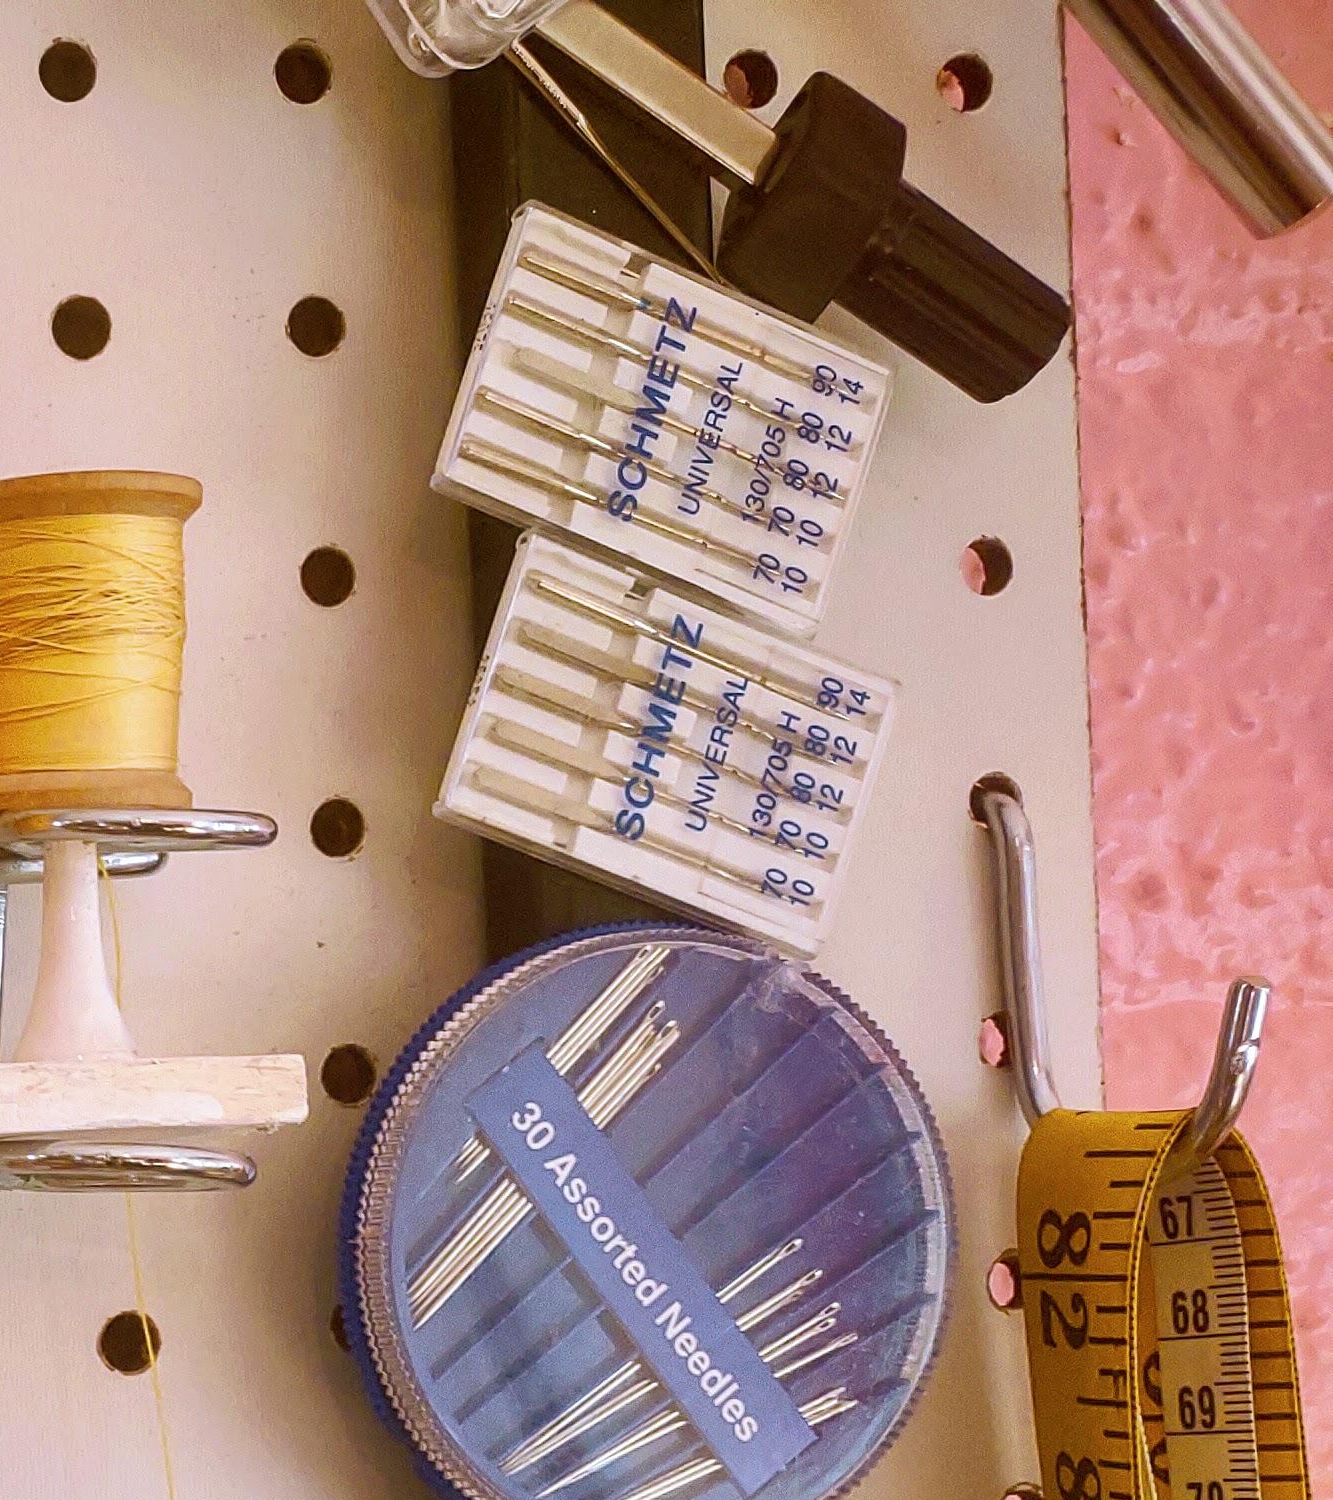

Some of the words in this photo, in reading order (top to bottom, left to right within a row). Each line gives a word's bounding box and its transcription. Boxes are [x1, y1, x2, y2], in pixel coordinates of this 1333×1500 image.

[607, 297, 697, 521] SCHMETZ
[678, 362, 743, 515] UNIVERSAL
[742, 426, 786, 523] 130/705
[774, 397, 794, 420] H
[753, 554, 781, 583] 70
[767, 505, 796, 533] 70
[783, 458, 809, 491] 80
[798, 411, 824, 444] 80
[813, 365, 838, 396] 90
[781, 566, 809, 594] 10
[796, 519, 824, 548] 10
[812, 473, 838, 500] 12
[825, 424, 852, 453] 12
[841, 376, 865, 405] 14
[615, 613, 704, 841] SCHMETZ
[684, 676, 749, 832] UNIVERSAL
[804, 724, 831, 757] 80
[817, 676, 844, 709] 90
[749, 741, 794, 838] 130/705
[781, 710, 802, 733] H
[774, 820, 802, 851] 70
[790, 772, 816, 804] 80
[791, 879, 815, 908] 10
[805, 831, 830, 860] 10
[819, 784, 844, 812] 12
[833, 735, 858, 766] 12
[847, 689, 872, 718] 14
[760, 867, 788, 898] 70
[510, 1101, 556, 1154] 30
[544, 1152, 667, 1307] Assorted
[654, 1300, 760, 1444] Needles
[1160, 1196, 1193, 1240] 67
[1172, 1290, 1210, 1336] 68
[1179, 1386, 1216, 1429] 69
